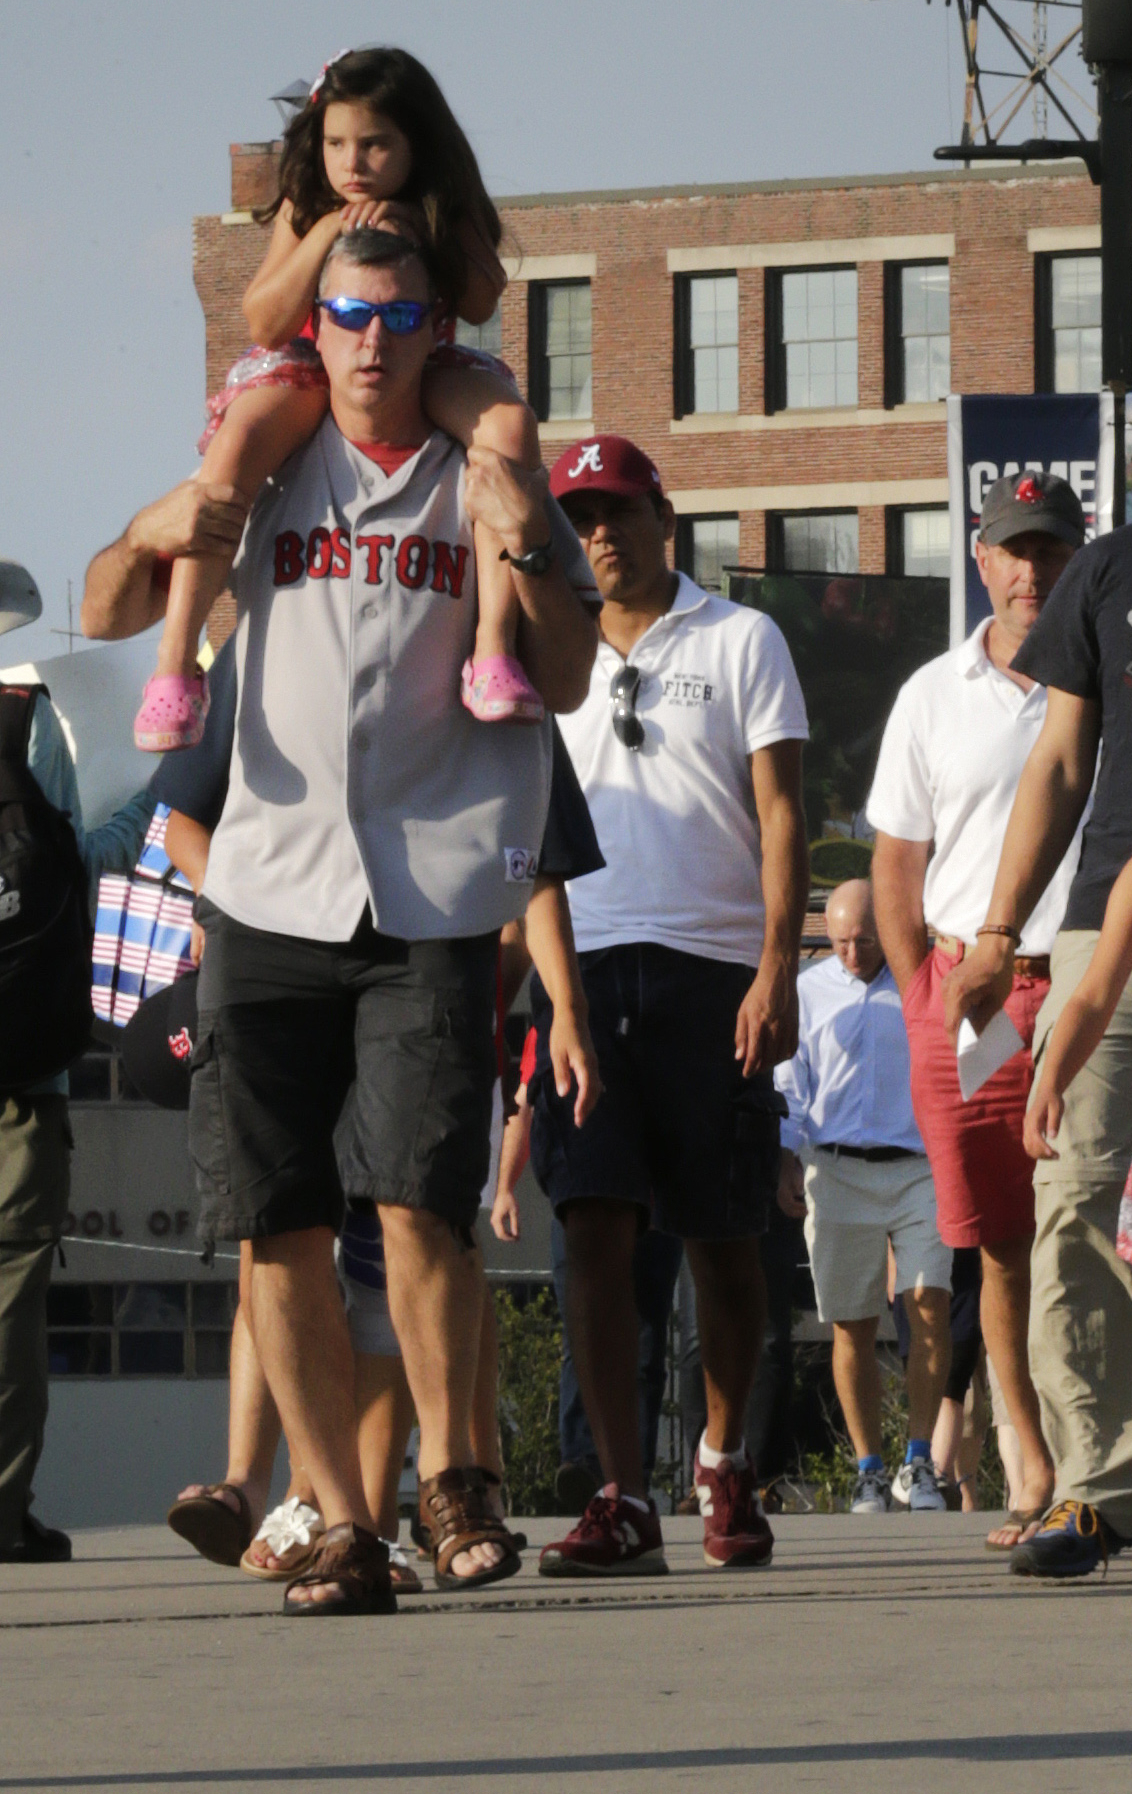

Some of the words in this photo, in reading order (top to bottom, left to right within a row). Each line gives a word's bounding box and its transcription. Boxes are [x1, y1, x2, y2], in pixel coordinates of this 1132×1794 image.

[568, 444, 603, 478] A
[969, 460, 1096, 514] GE
[273, 526, 469, 599] BOSTON
[662, 680, 713, 701] FITCH
[148, 1209, 190, 1237] OF
